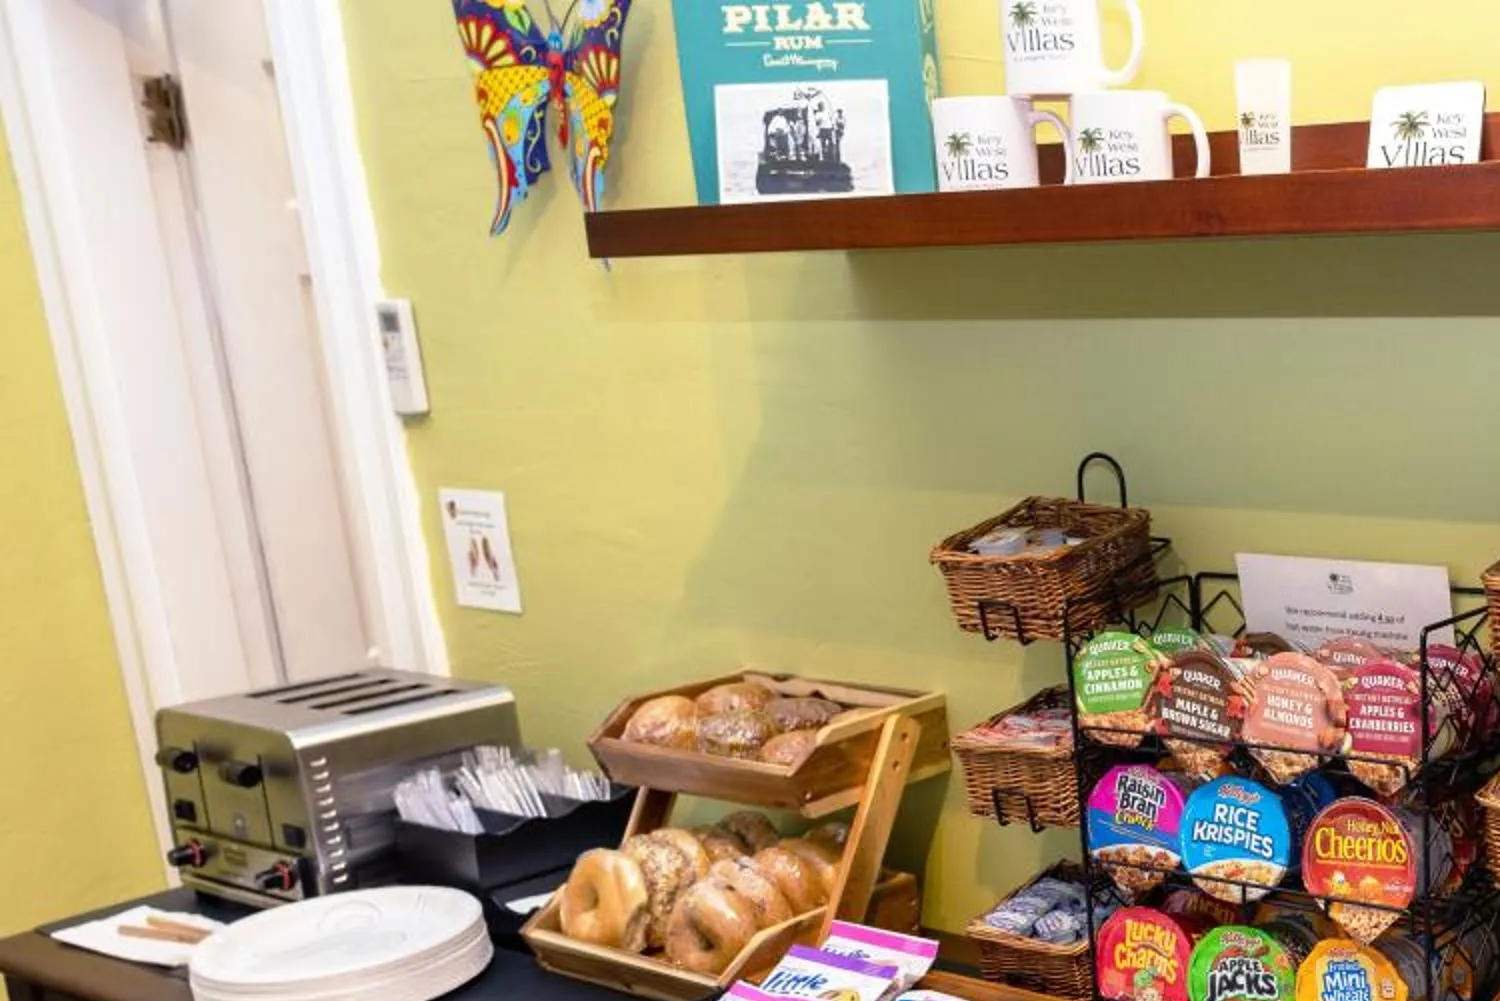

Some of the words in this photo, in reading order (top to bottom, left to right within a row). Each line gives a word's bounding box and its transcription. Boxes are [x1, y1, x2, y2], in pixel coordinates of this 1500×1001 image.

[721, 2, 872, 33] PILAR
[773, 36, 824, 50] RUM
[1007, 28, 1075, 52] Villas
[1381, 140, 1466, 167] Villas
[942, 158, 1009, 181] Villas
[1075, 153, 1141, 178] Villas
[1089, 641, 1130, 657] QUAKER
[1087, 667, 1127, 681] APPLES
[1129, 665, 1139, 678] &
[1183, 670, 1221, 690] QUAKER
[1271, 667, 1316, 687] QUAKER
[1361, 675, 1406, 691] QUAKER
[1085, 680, 1143, 695] CINNAMON
[1175, 698, 1209, 717] MAPLE
[1210, 707, 1219, 721] &
[1267, 694, 1303, 712] HONEY
[1359, 705, 1396, 718] APPLES
[1397, 706, 1406, 719] &
[1161, 707, 1198, 729] BROWN
[1199, 718, 1231, 739] SUGAR
[1263, 706, 1314, 729] ALMONDS
[1349, 715, 1416, 734] CRANBERRIES
[1117, 774, 1166, 807] Raisin
[1118, 791, 1157, 821] Bran
[1213, 802, 1260, 833] RICE
[1347, 819, 1379, 836] Honey
[1193, 821, 1273, 858] KRISPIES
[1315, 827, 1408, 864] Cheerios
[1114, 943, 1179, 986] Charms
[1219, 958, 1263, 973] APPLE
[761, 970, 830, 991] little
[1325, 971, 1367, 991] Mini
